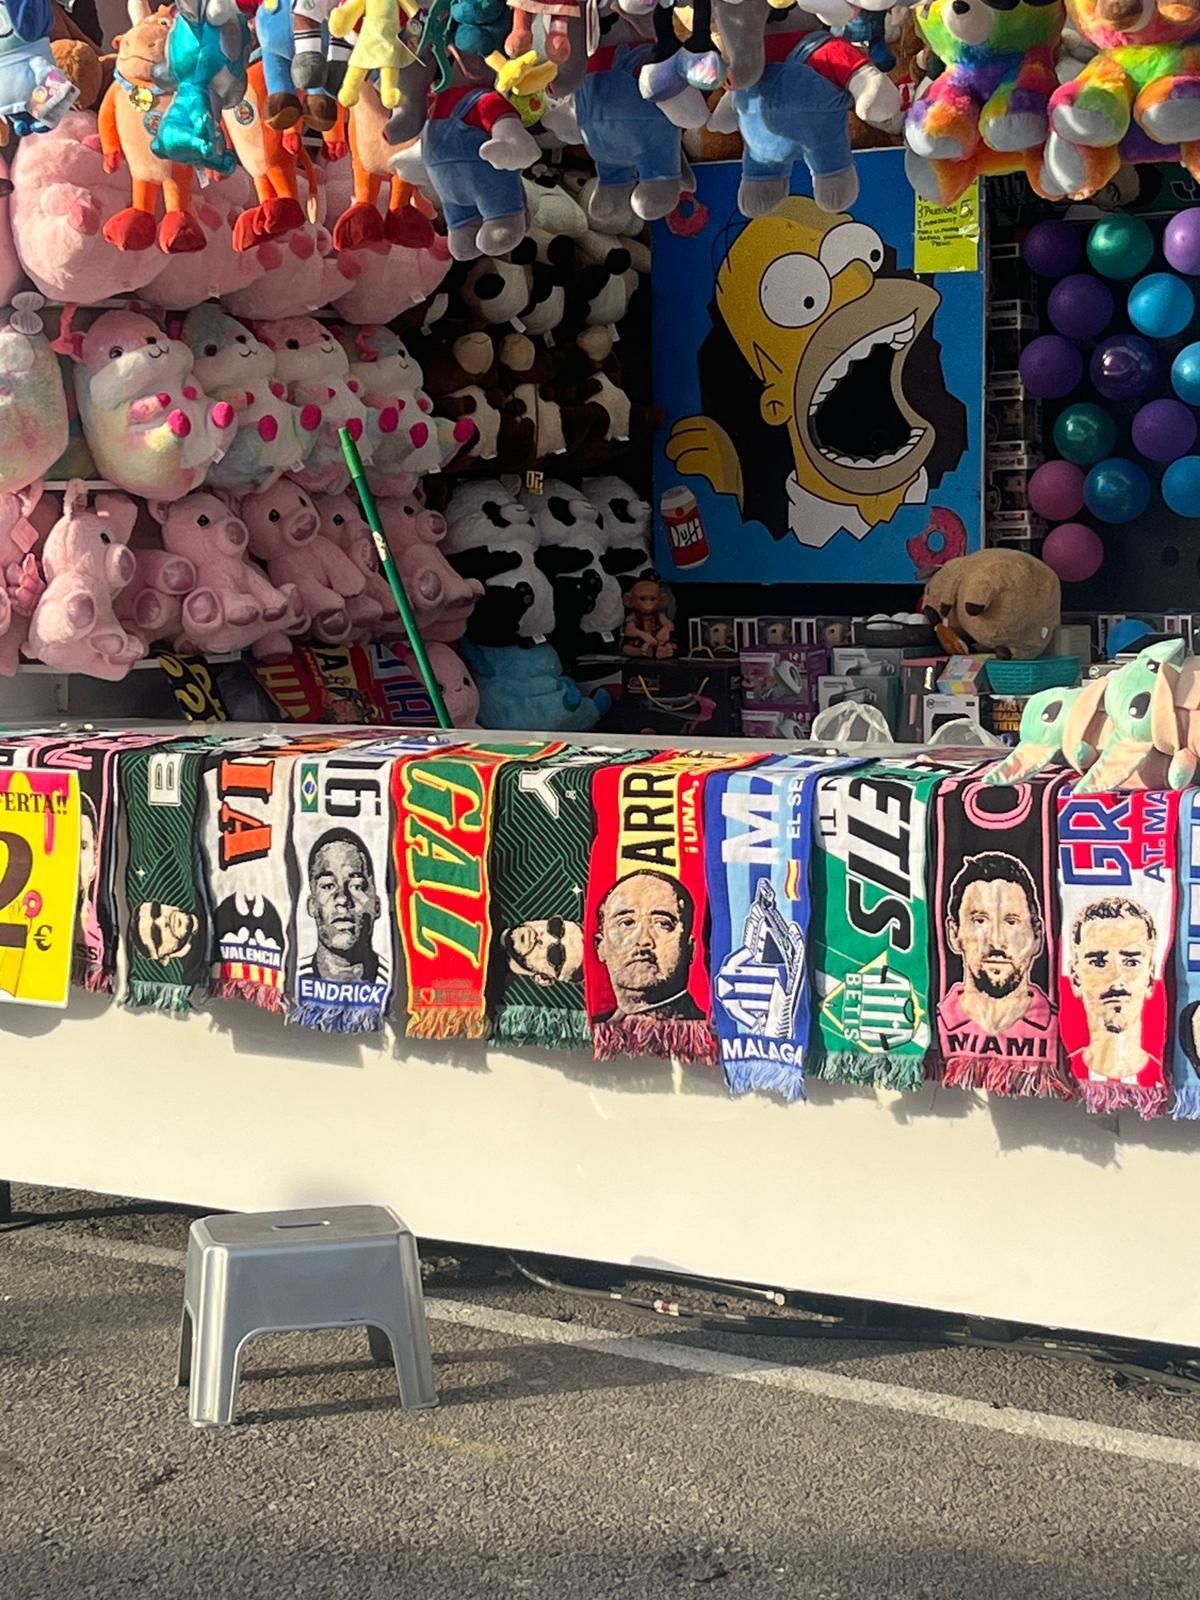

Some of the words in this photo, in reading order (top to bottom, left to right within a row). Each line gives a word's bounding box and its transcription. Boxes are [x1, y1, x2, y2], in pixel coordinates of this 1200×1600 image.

[0, 791, 67, 815] ERTA!!
[219, 945, 281, 967] VALENCIA
[300, 979, 385, 1004] ENDRICK
[843, 973, 862, 1041] BETIS
[721, 1037, 804, 1067] MALAGA
